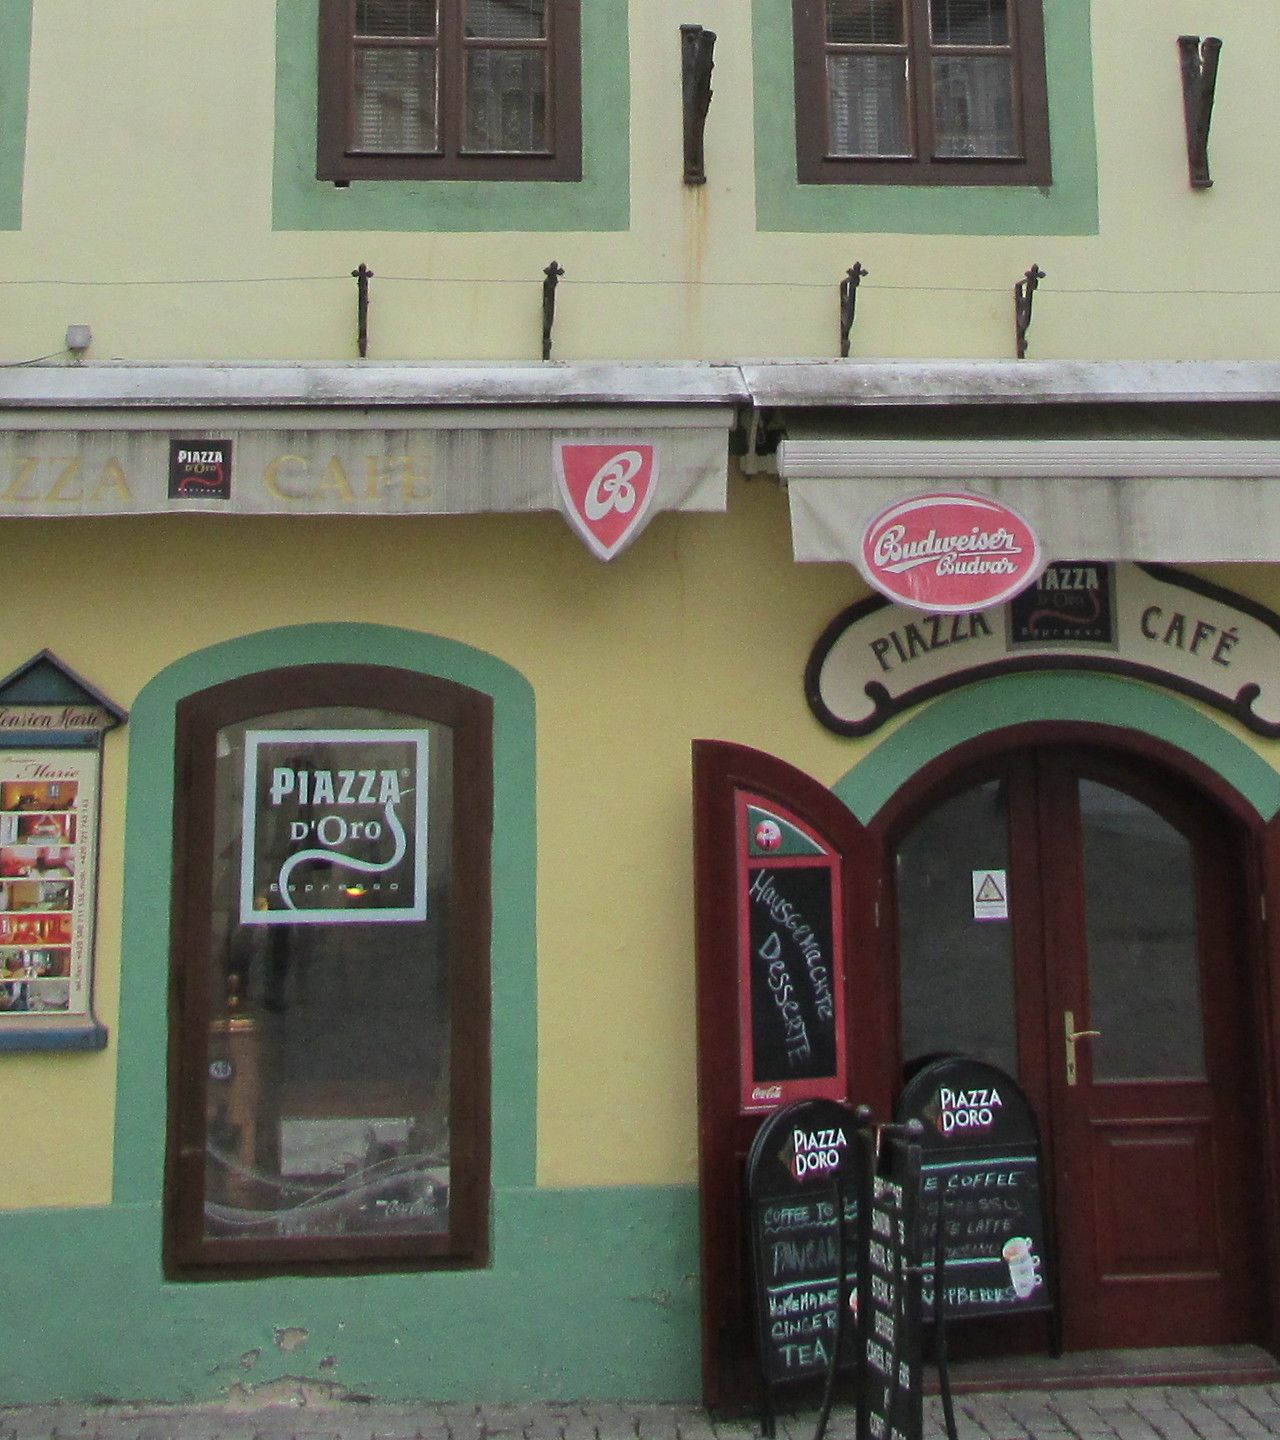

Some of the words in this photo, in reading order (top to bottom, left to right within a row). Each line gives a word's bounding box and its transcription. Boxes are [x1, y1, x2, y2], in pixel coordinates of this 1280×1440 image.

[178, 450, 223, 464] PIAZZA
[874, 525, 1021, 567] Budweiser
[935, 553, 1017, 576] Budvar
[869, 612, 992, 672] PIAZZA
[1140, 605, 1240, 667] CAFÉ
[270, 767, 401, 805] PIAZZA
[290, 815, 382, 846] D'Oro
[940, 1088, 1002, 1111] PIAZZA
[793, 1128, 847, 1153] PIAZZA
